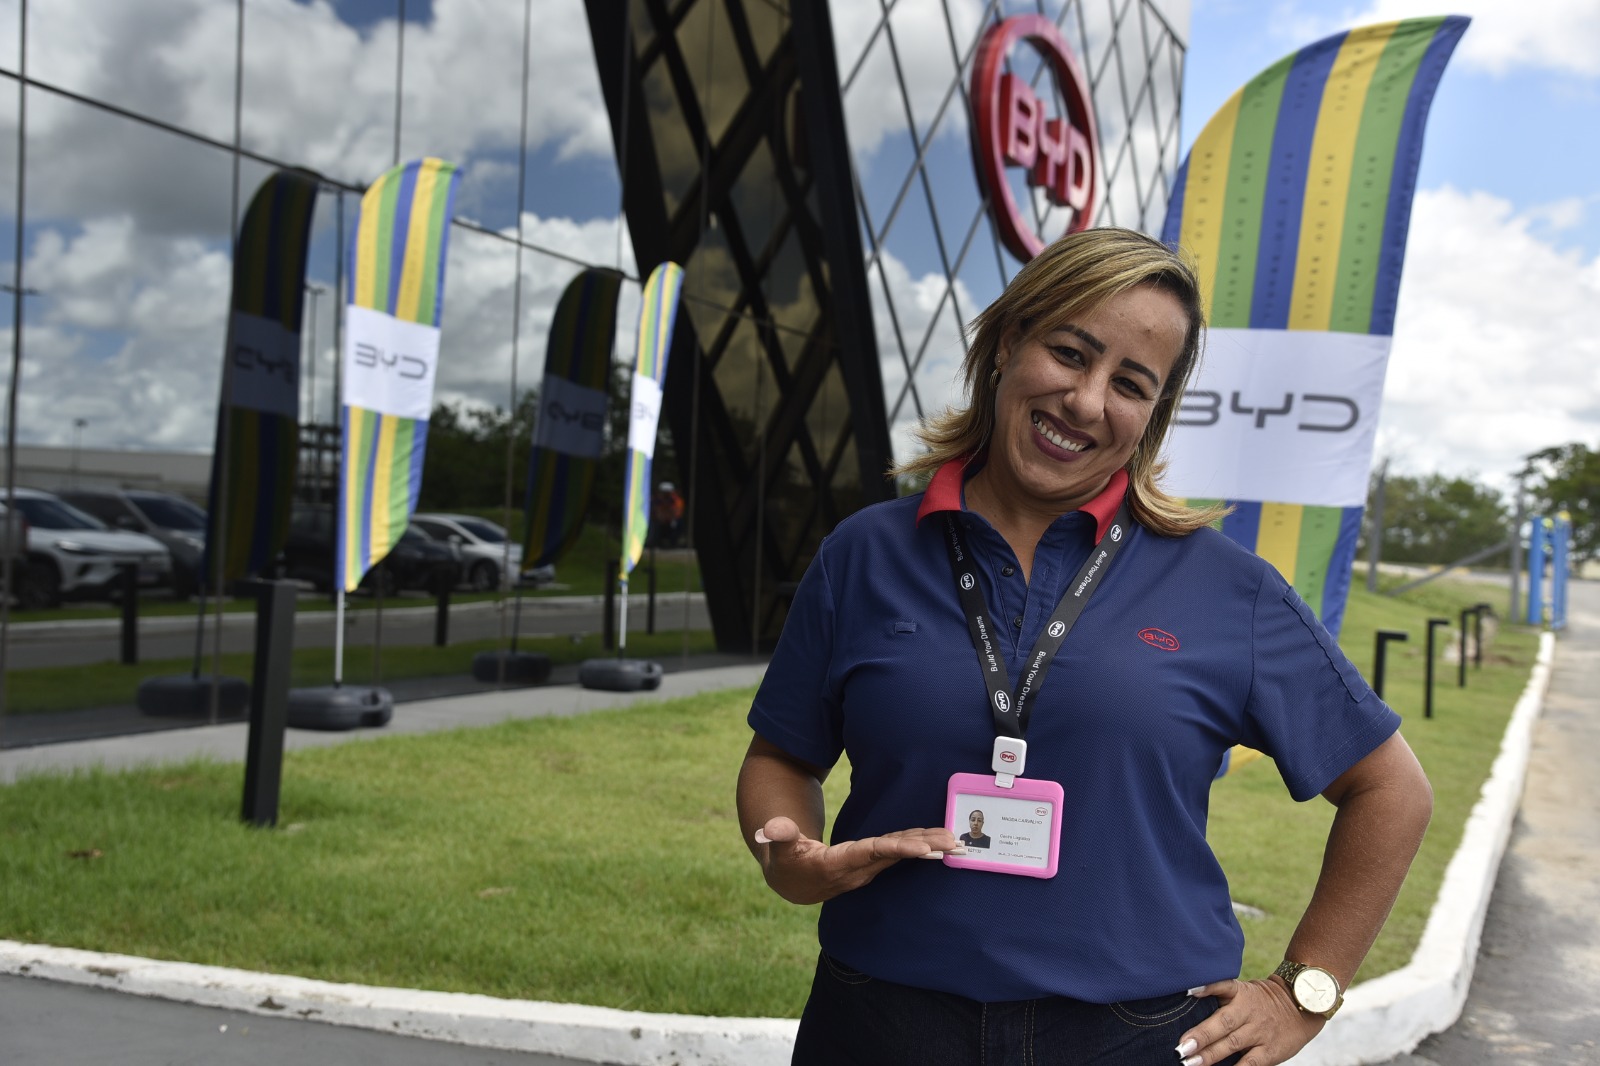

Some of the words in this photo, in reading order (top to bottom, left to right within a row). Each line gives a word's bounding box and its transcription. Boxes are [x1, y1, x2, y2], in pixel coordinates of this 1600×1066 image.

[1000, 73, 1091, 211] BYD
[355, 341, 427, 380] BYD
[1174, 390, 1360, 433] BYD
[1095, 550, 1108, 566] Build
[1088, 564, 1099, 578] Your
[1074, 575, 1092, 597] Dreams
[976, 615, 988, 640] Dreams
[984, 639, 992, 654] Your
[1144, 633, 1175, 647] BYD
[987, 654, 998, 672] Build
[1032, 650, 1046, 669] Build
[1025, 669, 1038, 687] Your
